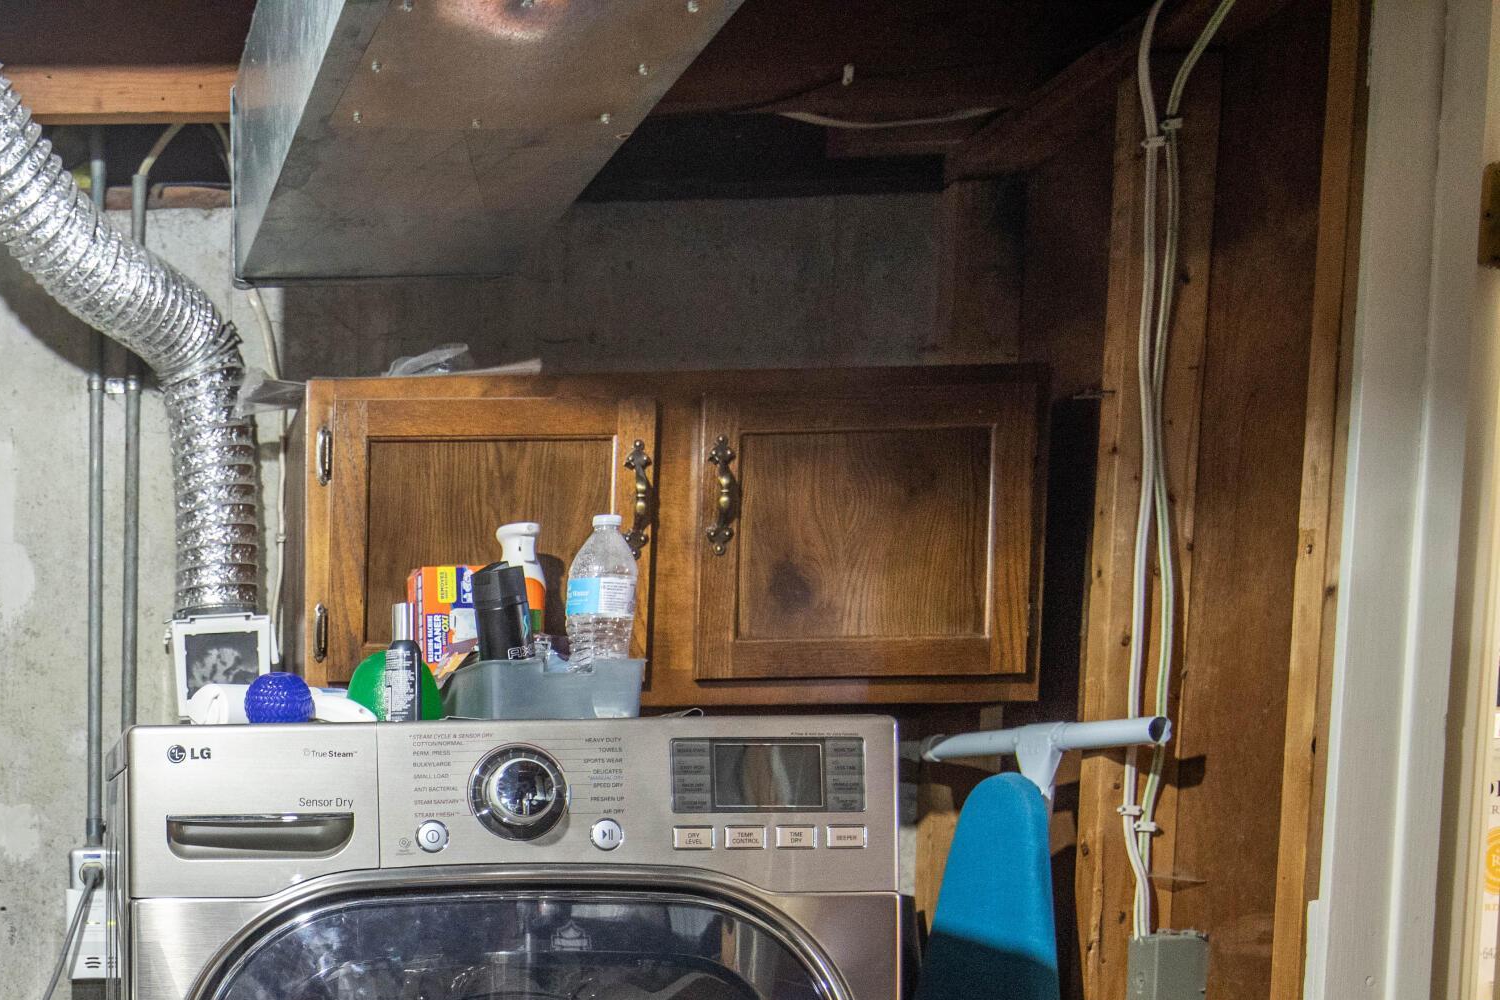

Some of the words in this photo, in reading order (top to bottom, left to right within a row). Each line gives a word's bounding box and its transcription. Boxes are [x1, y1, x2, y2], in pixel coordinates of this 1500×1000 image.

[434, 614, 442, 662] CLEANER
[190, 747, 211, 760] LG
[299, 797, 333, 807] Sensor
[336, 797, 353, 809] Dry
